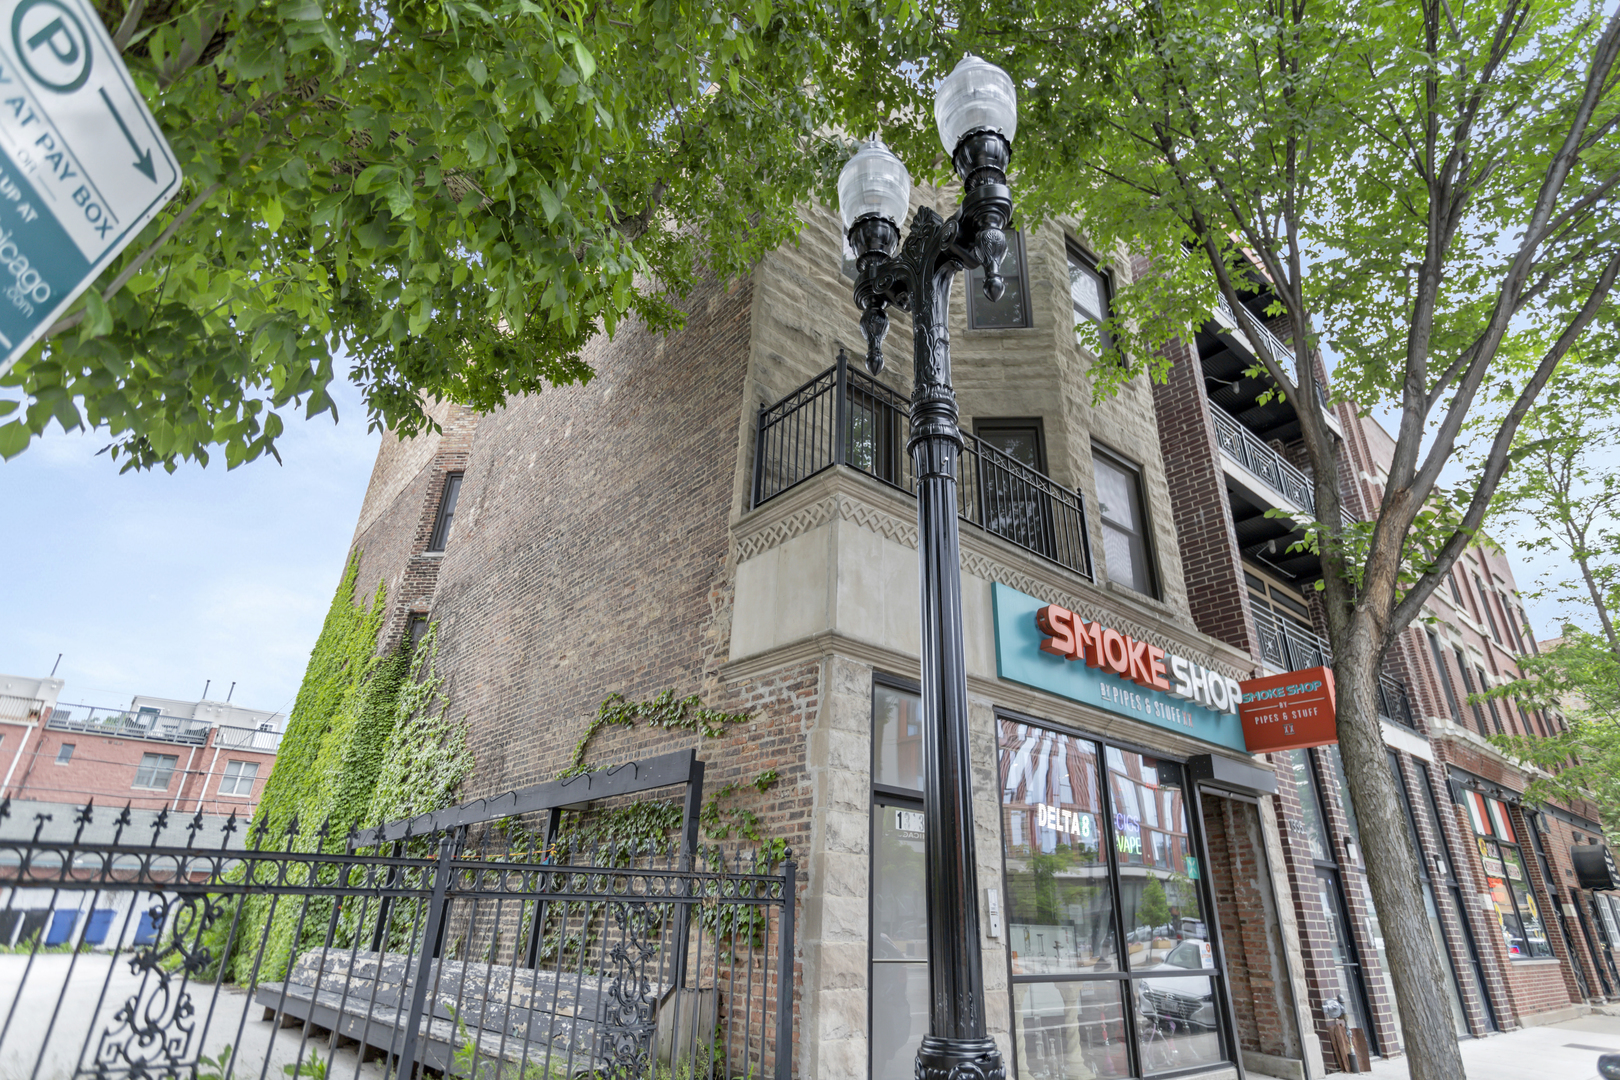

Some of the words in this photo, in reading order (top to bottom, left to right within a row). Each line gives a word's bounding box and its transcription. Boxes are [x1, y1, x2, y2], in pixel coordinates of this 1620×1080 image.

[5, 96, 40, 127] AT
[35, 132, 77, 181] PAY
[72, 184, 114, 240] BOX
[17, 149, 37, 174] OR
[16, 202, 38, 223] AT
[0, 227, 51, 303] icago
[1038, 603, 1170, 692] SMOKE
[1166, 654, 1243, 716] SHOP
[1100, 682, 1111, 698] BY
[1112, 686, 1142, 712] PIPES
[1144, 697, 1152, 714] &
[1153, 700, 1181, 724] STUFF
[1242, 686, 1286, 704] SMOKE
[1285, 680, 1322, 696] SHOP
[1254, 713, 1279, 725] PIPES
[1282, 711, 1288, 721] &
[1291, 706, 1318, 719] STUFF
[1278, 701, 1288, 709] BY
[1116, 834, 1143, 855] VAPE
